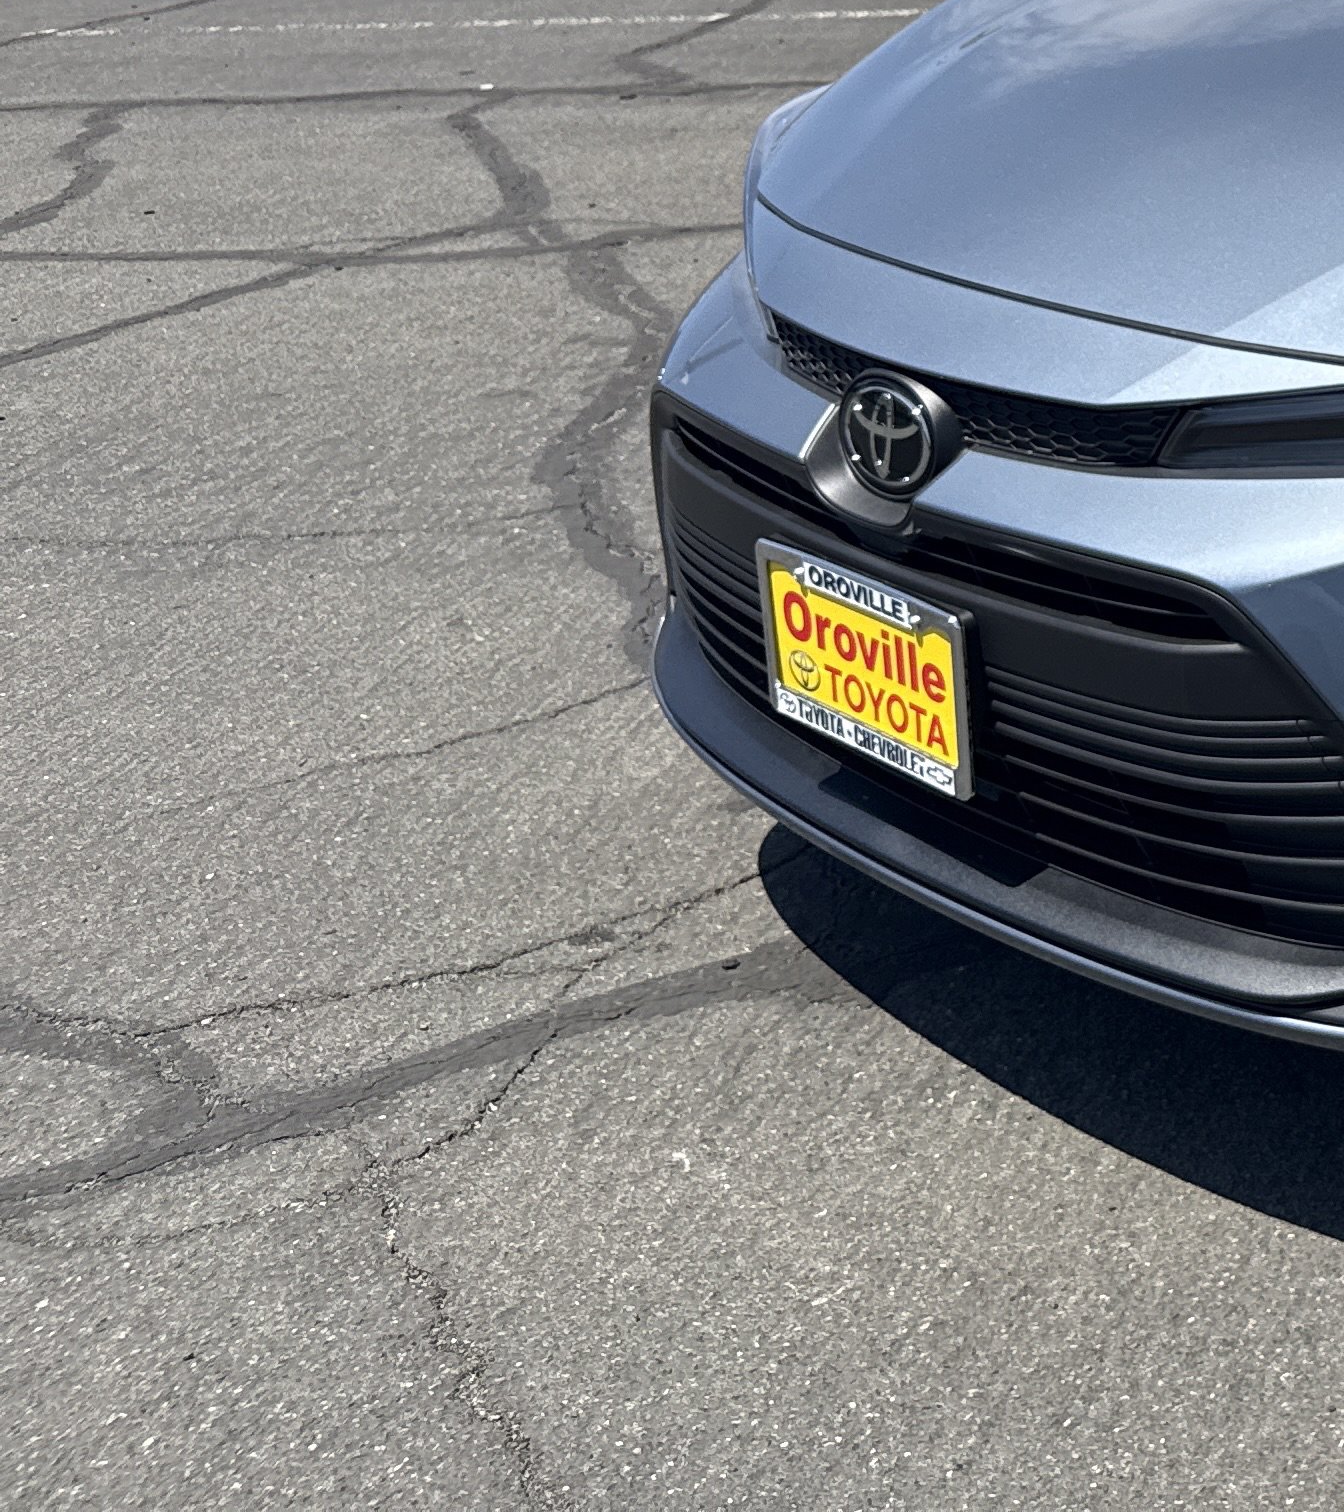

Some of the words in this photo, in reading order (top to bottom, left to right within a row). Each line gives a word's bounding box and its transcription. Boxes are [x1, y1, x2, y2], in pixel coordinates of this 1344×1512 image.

[809, 565, 906, 622] OROVILLE
[783, 590, 947, 703] Oroville
[797, 698, 846, 739] TOYOTA
[854, 724, 925, 777] CHEVROLET
[824, 663, 949, 756] TOYOTA
